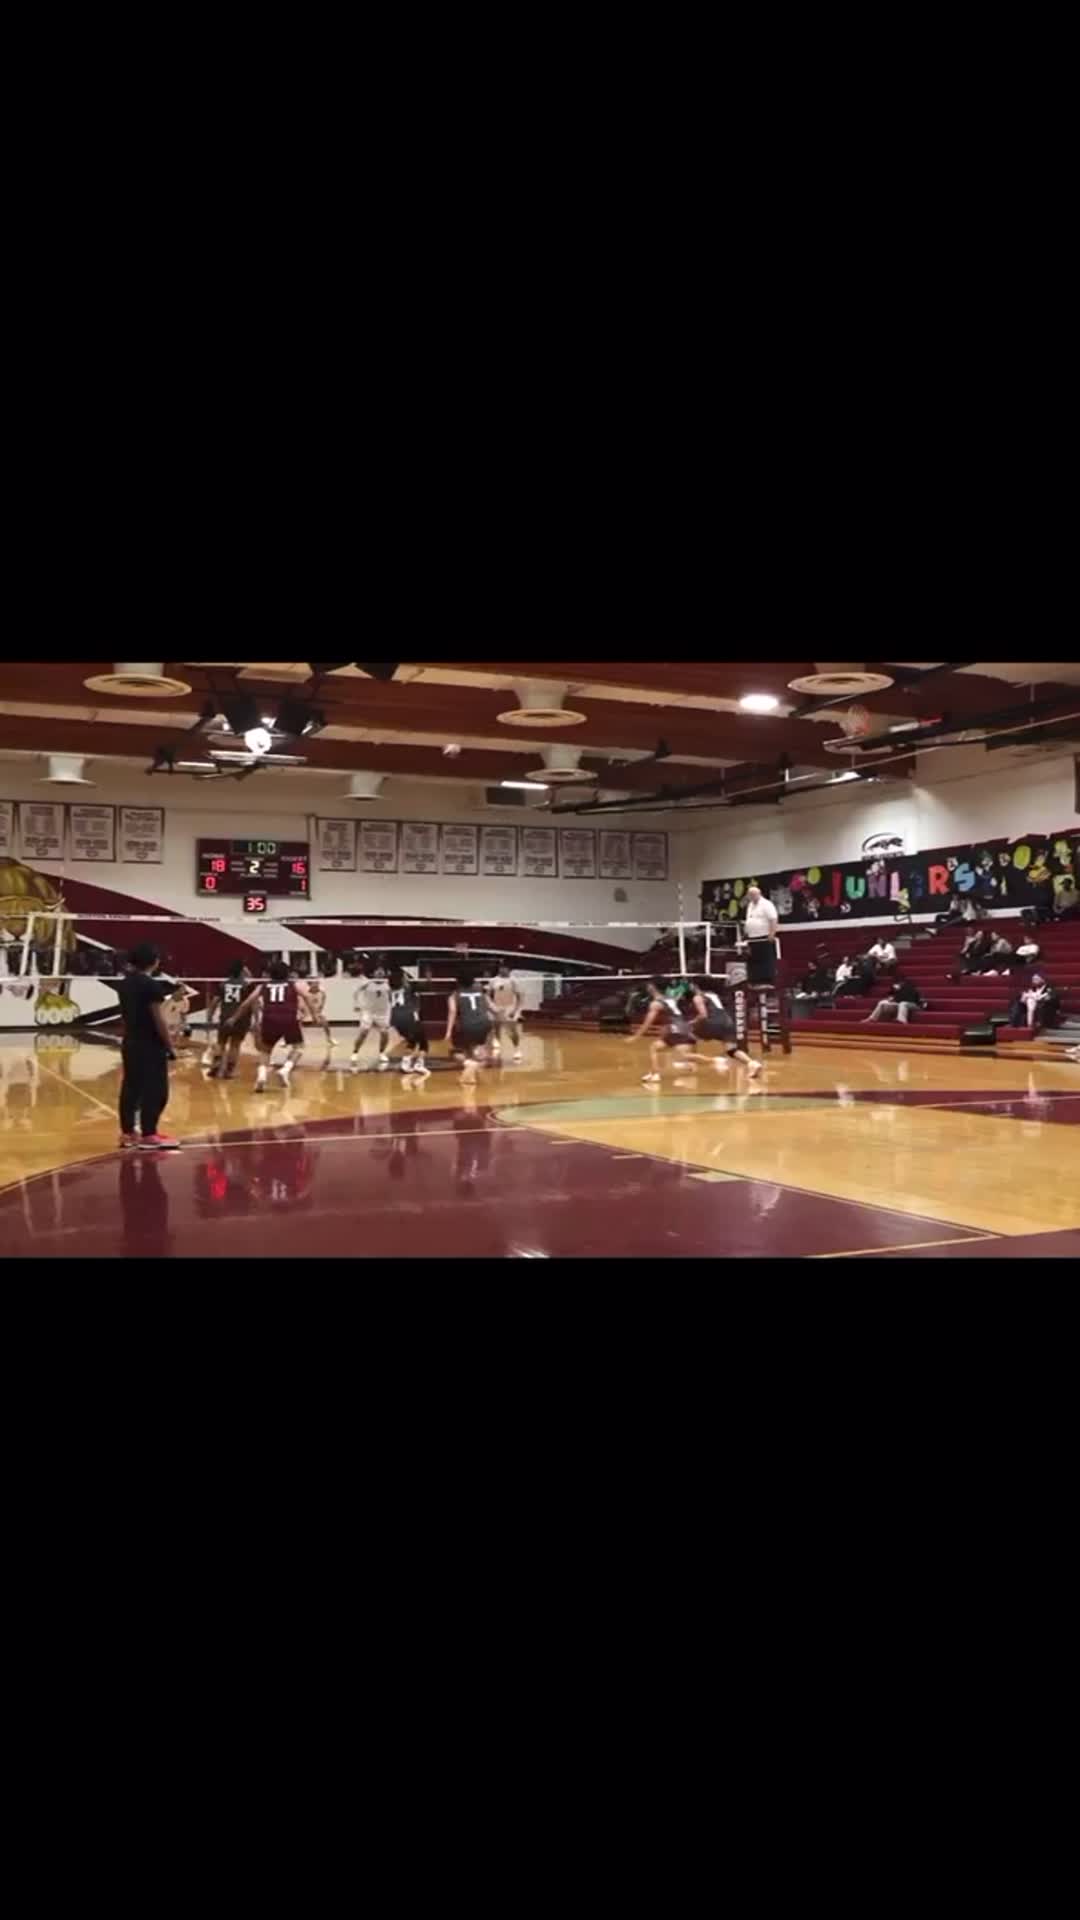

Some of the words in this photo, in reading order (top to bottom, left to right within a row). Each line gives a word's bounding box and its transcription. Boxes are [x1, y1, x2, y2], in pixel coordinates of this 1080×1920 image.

[249, 860, 260, 874] 2
[205, 876, 216, 889] 0
[300, 879, 307, 891] 1
[247, 897, 265, 911] 35
[225, 986, 240, 1003] 24
[269, 985, 285, 1002] 11
[734, 991, 745, 1040] COUGARS
